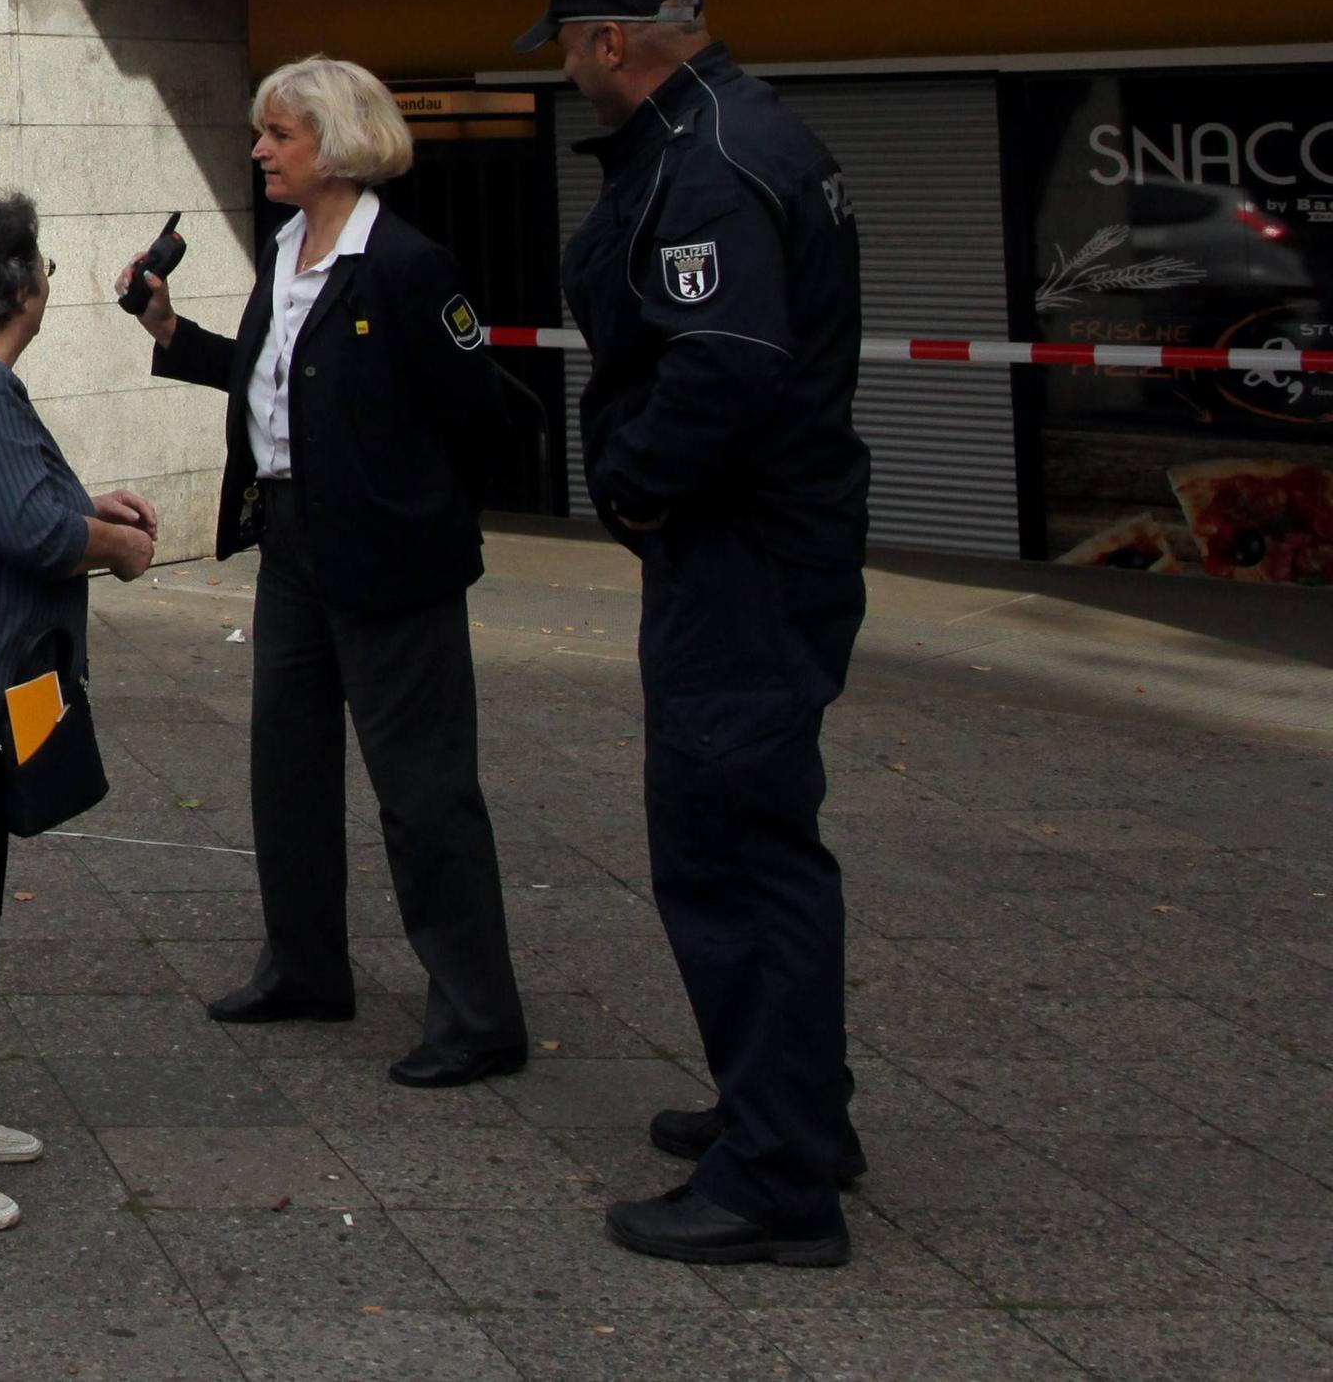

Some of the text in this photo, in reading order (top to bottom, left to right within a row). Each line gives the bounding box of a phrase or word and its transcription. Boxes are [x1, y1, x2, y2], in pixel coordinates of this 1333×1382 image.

[396, 96, 443, 111] andau
[1266, 198, 1333, 214] by Ba
[665, 245, 713, 261] POLIZEI
[1069, 320, 1190, 344] FRISCHE
